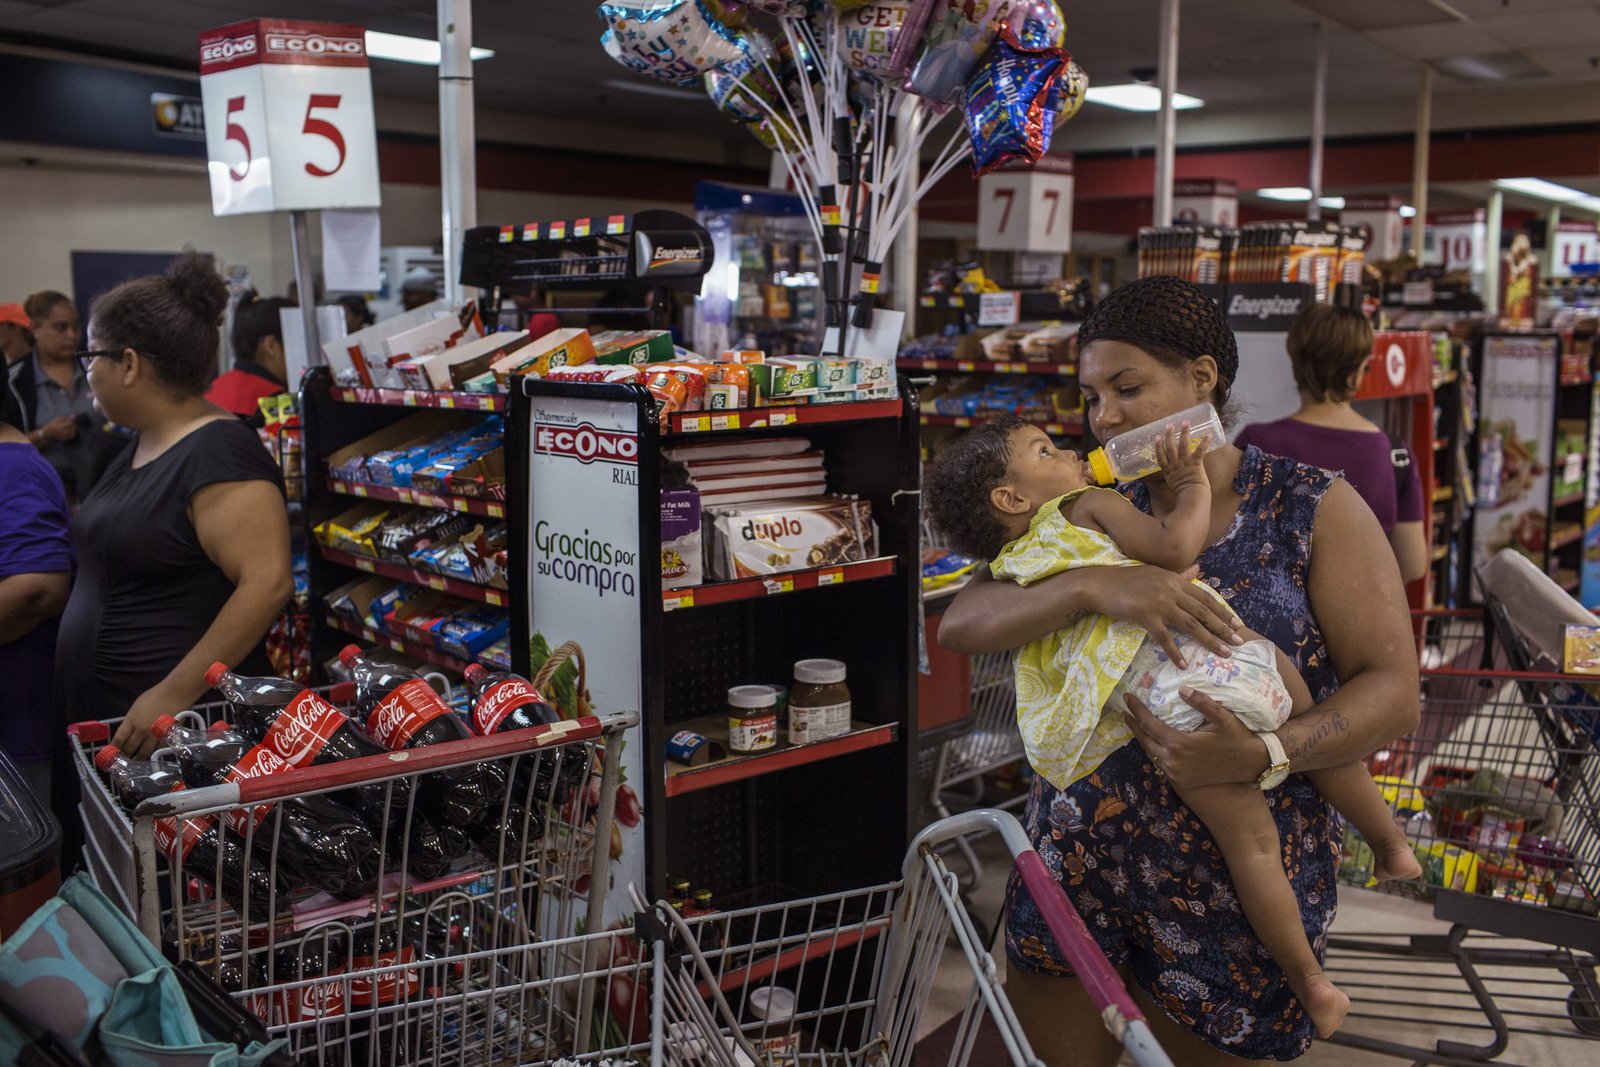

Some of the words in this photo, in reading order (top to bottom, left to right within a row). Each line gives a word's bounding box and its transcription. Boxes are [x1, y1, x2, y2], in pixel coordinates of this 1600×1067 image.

[203, 40, 256, 60] ECONO
[270, 38, 360, 53] ECONO
[850, 50, 890, 70] SOO
[994, 57, 1020, 107] Happy
[225, 95, 252, 182] 5
[302, 93, 346, 177] 5
[994, 187, 1015, 235] 7
[1043, 189, 1060, 235] 7
[654, 246, 700, 261] Energizer
[1440, 233, 1472, 265] 10
[1228, 294, 1301, 319] Energizer
[538, 429, 638, 456] ECONO
[612, 468, 639, 486] RIAL
[535, 520, 612, 565] Gracias
[614, 549, 636, 567] por
[742, 516, 803, 542] duplo
[537, 561, 551, 576] su
[552, 557, 635, 597] compra
[661, 565, 688, 575] ORDEN
[477, 680, 528, 728] Coca-Cola
[273, 694, 328, 755] Coca-Cola
